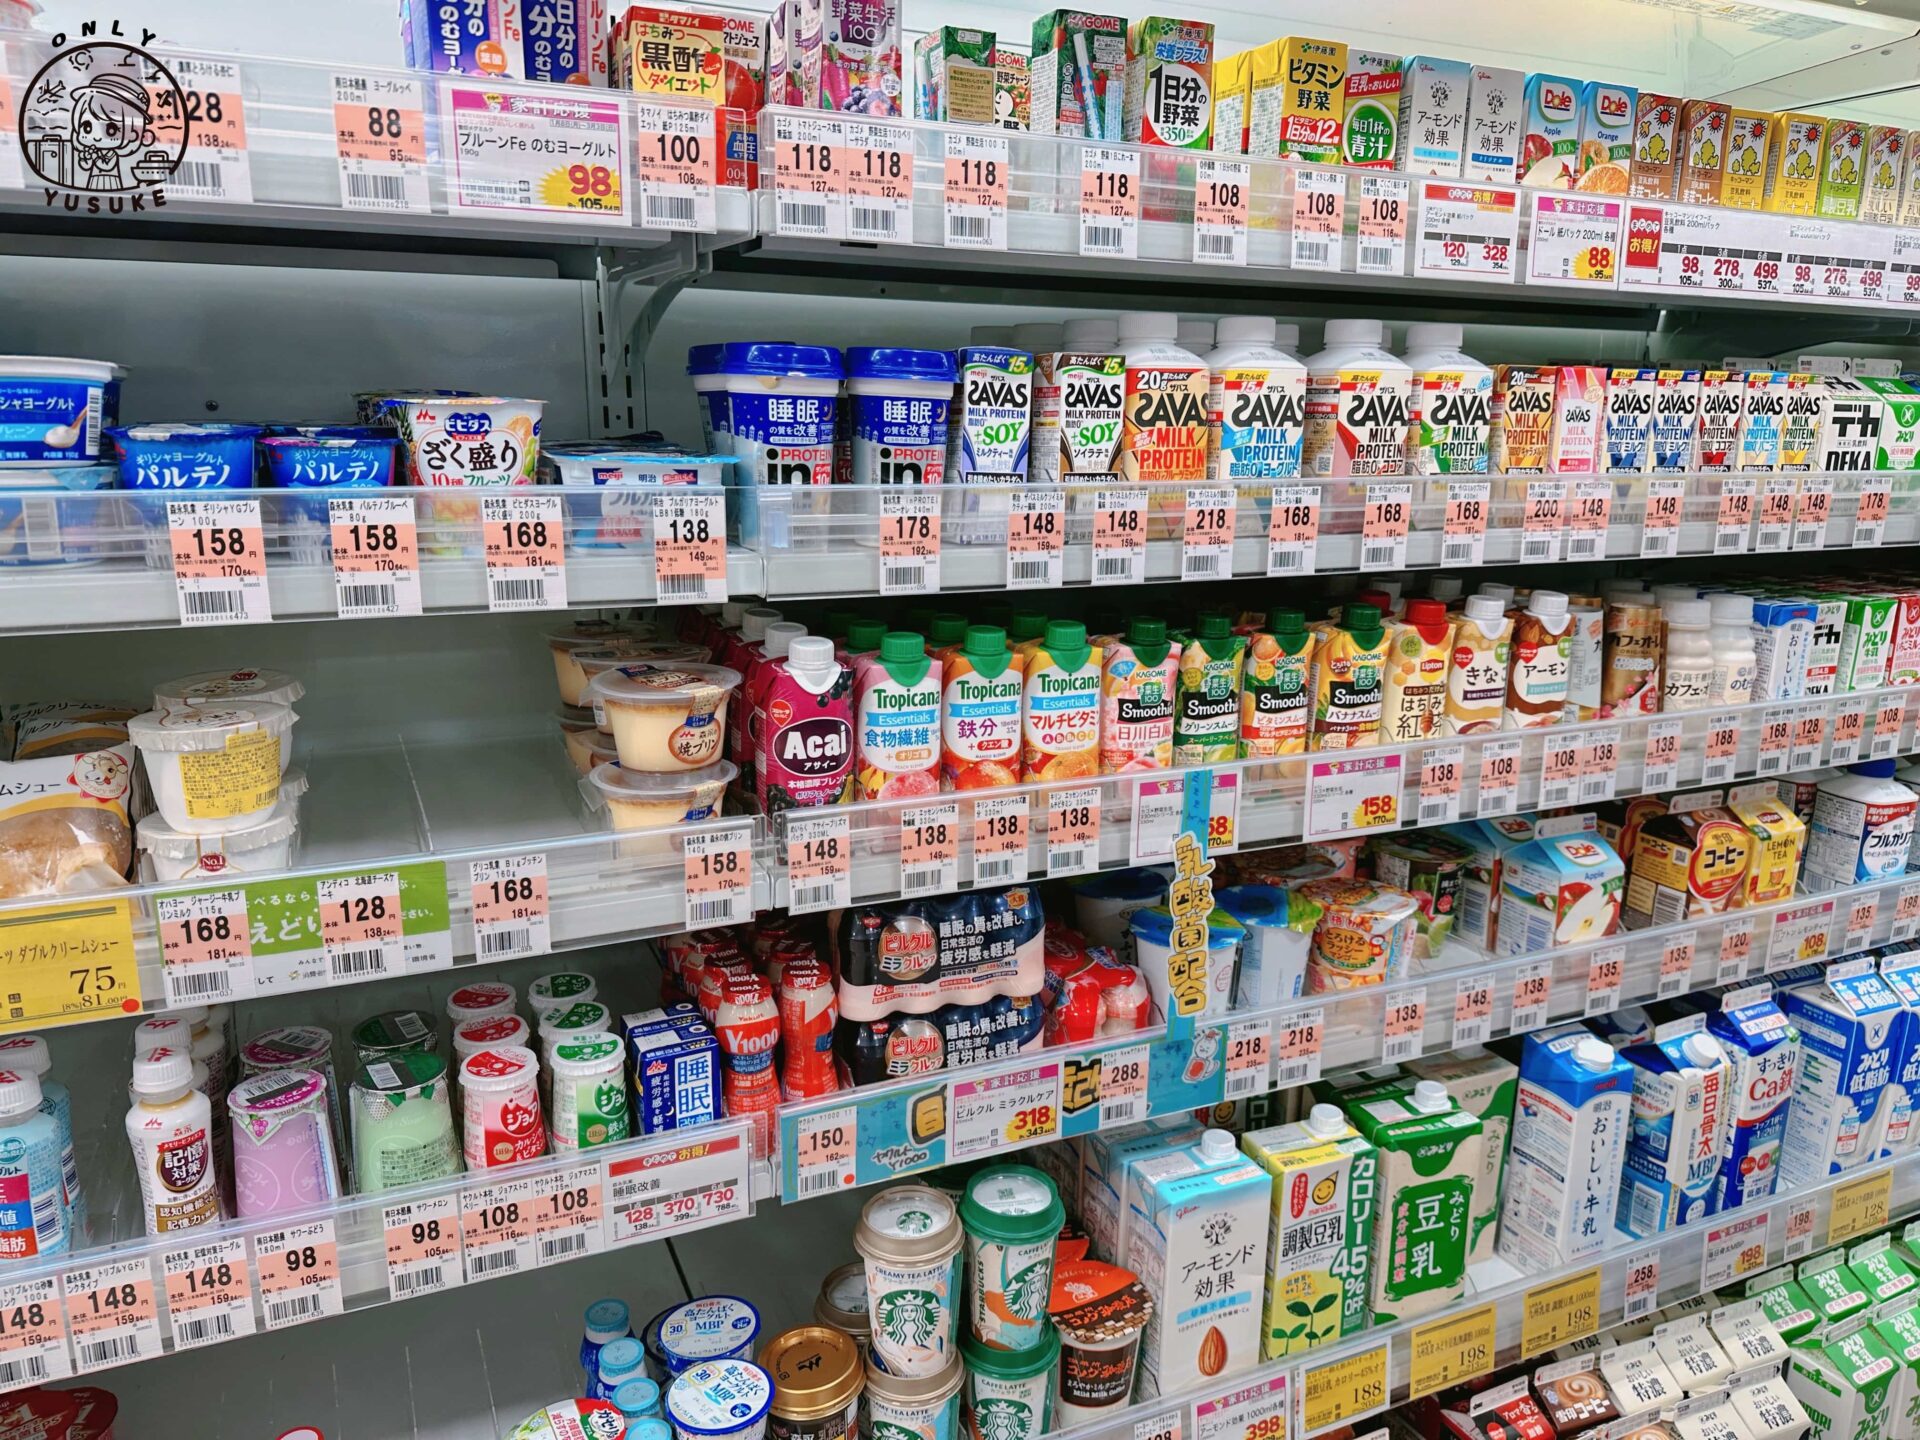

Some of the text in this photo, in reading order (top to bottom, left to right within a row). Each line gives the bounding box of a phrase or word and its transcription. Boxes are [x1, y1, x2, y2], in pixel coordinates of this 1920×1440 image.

[831, 1, 895, 29] 野菜生活
[1067, 15, 1121, 33] KAGOME
[635, 22, 687, 41] はちみつ
[847, 25, 884, 41] 100
[641, 42, 706, 75] 黒酢
[1311, 45, 1337, 60] 伊藤園
[648, 72, 712, 94] ダイエット
[1289, 58, 1345, 90] ビタミン
[1348, 74, 1400, 96] 豆乳でおいしい
[509, 96, 591, 120] 家計応援
[1296, 89, 1331, 111] 野菜
[1544, 88, 1572, 105] Dole
[1600, 94, 1627, 112] Dole
[368, 107, 402, 139] 88
[1162, 104, 1200, 127] 野菜
[1417, 109, 1463, 128] アーモンド
[1473, 117, 1517, 137] アーモンド
[1423, 127, 1450, 147] 効果
[1543, 126, 1562, 138] Apple
[1597, 131, 1619, 143] Orange
[657, 135, 700, 163] 100
[1350, 135, 1388, 158] 青汁
[1480, 136, 1505, 155] 効果
[792, 144, 831, 172] 118
[864, 150, 901, 178] 118
[567, 163, 613, 197] 98
[961, 159, 997, 188] 118
[1096, 172, 1129, 198] 118
[1210, 182, 1240, 207] 108
[1307, 191, 1335, 216] 108
[1371, 198, 1399, 222] 108
[1566, 201, 1606, 215] 家計応援
[1587, 247, 1611, 268] 88
[1628, 238, 1658, 256] お得!
[769, 399, 820, 424] 睡眠
[884, 399, 932, 424] 睡眠
[968, 408, 1026, 420] MILK PROTEIN
[1832, 402, 1880, 438] デカ
[444, 417, 492, 434] ビヒダス
[770, 424, 819, 437] の質を改善
[982, 421, 1024, 446] SOY
[1079, 421, 1120, 446] SOY
[1156, 427, 1196, 447] MILK
[1256, 427, 1288, 445] MILK
[1610, 428, 1648, 441] PROTEIN
[136, 451, 224, 465] ギリシャヨーグルト
[422, 439, 519, 472] ざく盛り
[780, 449, 832, 463] PROTEIN
[894, 449, 943, 463] PROTEIN
[1073, 448, 1103, 459] ソイラテ
[1138, 449, 1204, 470] PROTEIN
[1243, 446, 1300, 463] PROTEIN
[136, 465, 232, 489] パルテノ
[293, 462, 380, 483] パルテノ
[1022, 512, 1055, 535] 148
[1107, 511, 1138, 532] 148
[1196, 508, 1226, 530] 218
[1283, 506, 1311, 526] 168
[349, 524, 399, 552] 158
[502, 522, 548, 550] 168
[669, 519, 710, 545] 138
[895, 516, 930, 540] 178
[192, 527, 246, 558] 158
[1203, 661, 1235, 672] KAGOME
[1352, 652, 1383, 664] KAGOME
[1422, 661, 1443, 671] Lipton
[1037, 672, 1100, 695] Tropicana
[1135, 669, 1167, 680] KAGOME
[872, 688, 942, 711] Tropicana
[878, 710, 931, 726] Essentials
[956, 718, 999, 739] 鉄分
[677, 738, 720, 758] 焼プリン
[783, 726, 847, 760] Acai
[864, 728, 930, 748] 食物繊維
[1553, 750, 1575, 768] 108
[1592, 744, 1613, 762] 138
[803, 760, 837, 771] アサイー
[1429, 764, 1454, 784] 138
[1490, 758, 1513, 777] 108
[986, 815, 1018, 837] 138
[1059, 807, 1090, 828] 138
[913, 824, 948, 847] 138
[803, 838, 846, 863] 148
[1566, 841, 1596, 858] Dole
[1703, 846, 1744, 869] コーヒー
[1772, 848, 1788, 860] TEA
[700, 851, 738, 876] 158
[1583, 869, 1605, 882] Apple
[490, 877, 533, 904] 168
[339, 896, 386, 924] 128
[180, 915, 232, 945] 168
[938, 910, 1026, 936] 睡眠の質を改善し、
[1168, 836, 1213, 1015] 乳酸菌配合
[18, 941, 120, 962] ダブルクリームシュー
[883, 933, 933, 953] ピルクル
[939, 938, 1016, 967] 疲労感を軽減
[727, 1027, 780, 1054] Y1000
[1758, 1050, 1796, 1076] すっきり
[1857, 1048, 1890, 1071] みどり
[677, 1054, 711, 1112] 睡眠
[1110, 1062, 1140, 1083] 288
[1849, 1070, 1890, 1094] 低脂肪
[998, 1090, 1054, 1111] ミラクルケア
[1013, 1105, 1051, 1131] 318
[1696, 1072, 1721, 1158] 毎日骨太
[809, 1127, 844, 1153] 150
[164, 1139, 204, 1169] 記憶
[171, 1161, 201, 1180] 対策
[1580, 1116, 1609, 1236] おいしい牛乳
[1687, 1156, 1718, 1181] MBP
[550, 1187, 589, 1213] 108
[613, 1179, 660, 1199] 睡眠改善
[478, 1203, 520, 1229] 108
[411, 1221, 441, 1244] 98
[1281, 1215, 1344, 1259] 調製豆乳
[1410, 1195, 1446, 1279] 豆乳
[285, 1245, 317, 1271] 98
[1181, 1243, 1257, 1283] アーモンド
[184, 1263, 233, 1292] 148
[874, 1264, 946, 1279] CREAMY TEA LATTE
[1194, 1272, 1236, 1302] 効果
[694, 1319, 725, 1332] MBP
[1005, 1382, 1027, 1392] LATTE
[1631, 1377, 1667, 1402] 特濃
[1555, 1398, 1611, 1424] 雪印コーヒー
